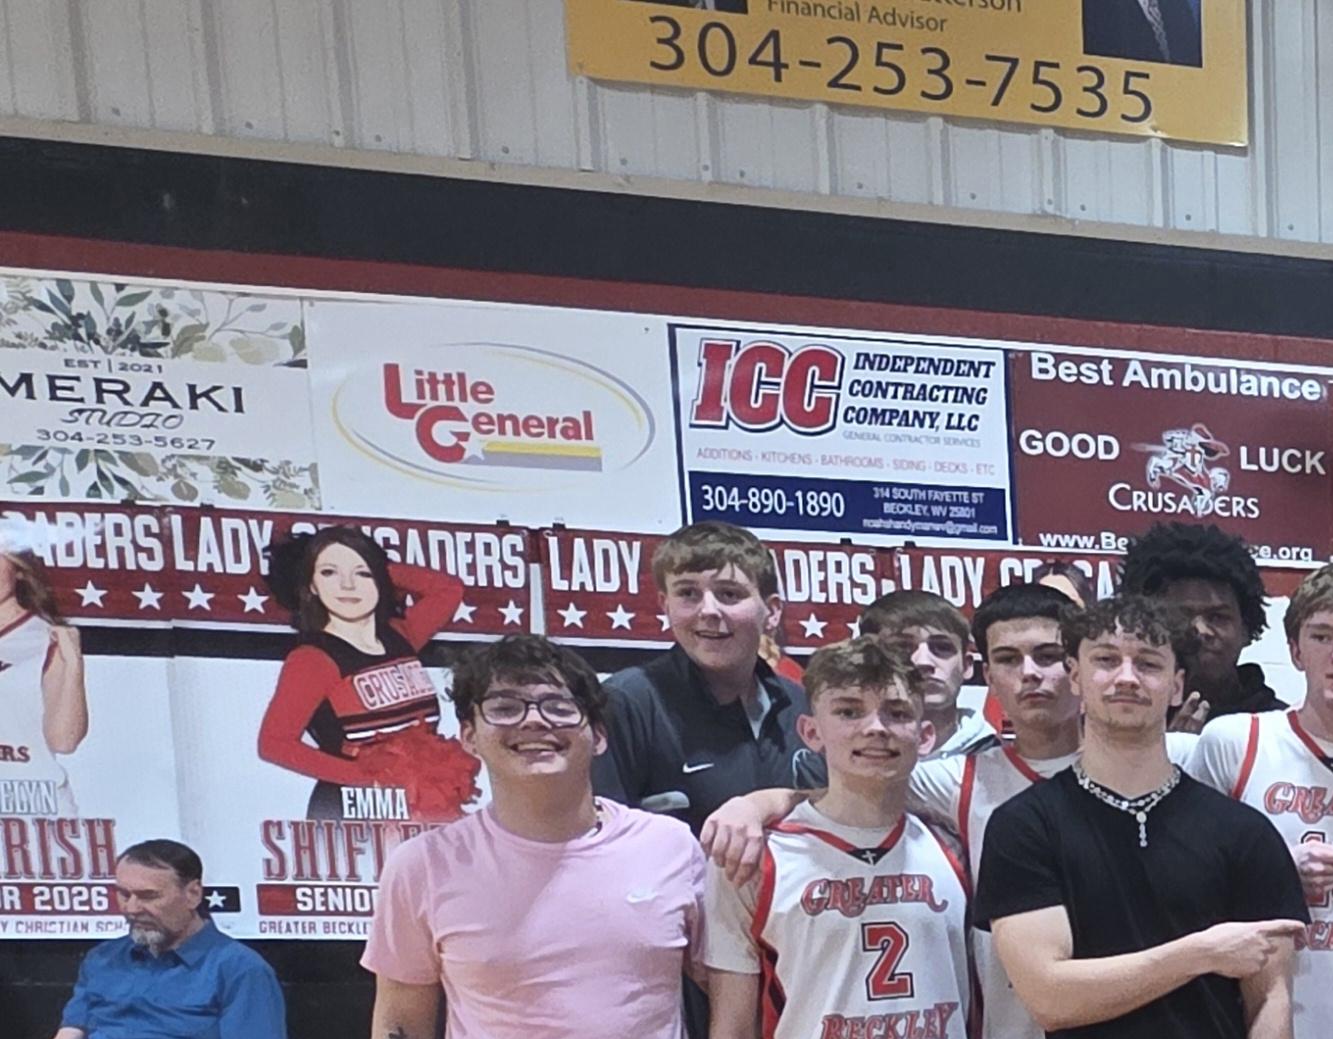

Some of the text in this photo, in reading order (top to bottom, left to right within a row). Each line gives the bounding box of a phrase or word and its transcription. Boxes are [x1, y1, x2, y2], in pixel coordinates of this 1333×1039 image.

[767, 0, 948, 32] Financial Advisor
[648, 14, 1154, 123] 304-253-7535
[63, 358, 163, 374] EST 2021
[853, 352, 996, 379] INDEPENDENT
[1030, 352, 1322, 401] Best Ambulance
[0, 372, 245, 414] MERAKI
[384, 363, 495, 420] Little
[690, 338, 845, 437] ICC
[848, 378, 988, 406] CONTRACTING
[60, 407, 184, 430] STUDIO
[842, 406, 981, 433] COMPANY, LLC
[36, 428, 216, 451] 304-253-5627
[415, 404, 595, 464] General
[842, 430, 981, 449] GENERAL CONTRACTOR SERVICES
[696, 447, 995, 476] ADDITIONS KITCHENS BATHROOMS SIDING DECKS ETC
[1019, 429, 1327, 475] GOOD LUCK
[701, 484, 845, 518] 304-890-1890
[872, 487, 984, 504] 314 SOUTH FAYETTE ST
[1108, 482, 1260, 519] CRUSADERS
[931, 504, 947, 517] WV
[949, 506, 976, 518] 25801
[172, 514, 273, 576] LADY
[549, 535, 642, 594] LADY
[340, 786, 410, 820] EMMA
[32, 885, 109, 912] 2026
[295, 885, 379, 913] SENIO
[800, 873, 949, 918] GREATER
[15, 920, 90, 934] CHRISTIAN
[258, 919, 372, 935] GREATER BECKLE
[861, 921, 915, 1001] 2
